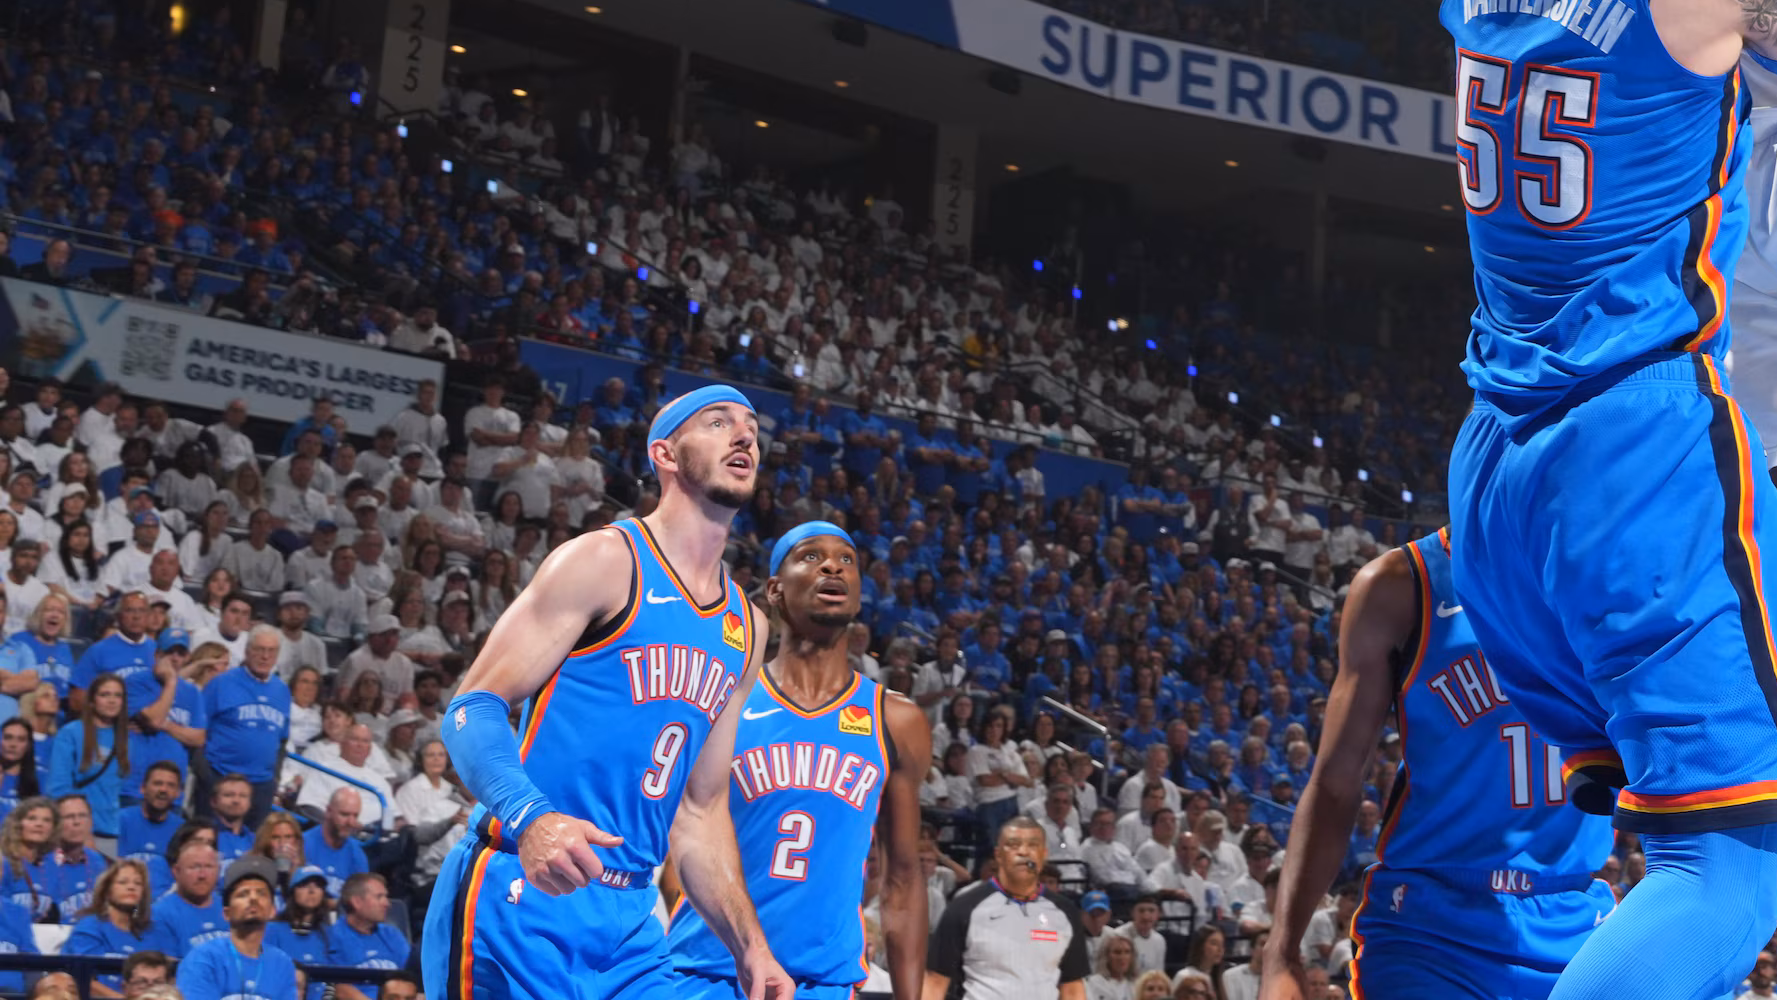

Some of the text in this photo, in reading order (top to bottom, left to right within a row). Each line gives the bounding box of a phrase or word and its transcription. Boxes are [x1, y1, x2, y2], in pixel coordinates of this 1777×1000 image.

[402, 3, 426, 92] 225
[1041, 15, 1398, 146] SUPERIOR
[1455, 47, 1600, 232] 55
[184, 363, 374, 412] GAS PRODUCER
[185, 338, 320, 378] AMERICA'S
[620, 643, 738, 726] THUNDE
[641, 722, 688, 799] 9
[730, 741, 879, 812] THUNDER
[769, 809, 815, 882] 2
